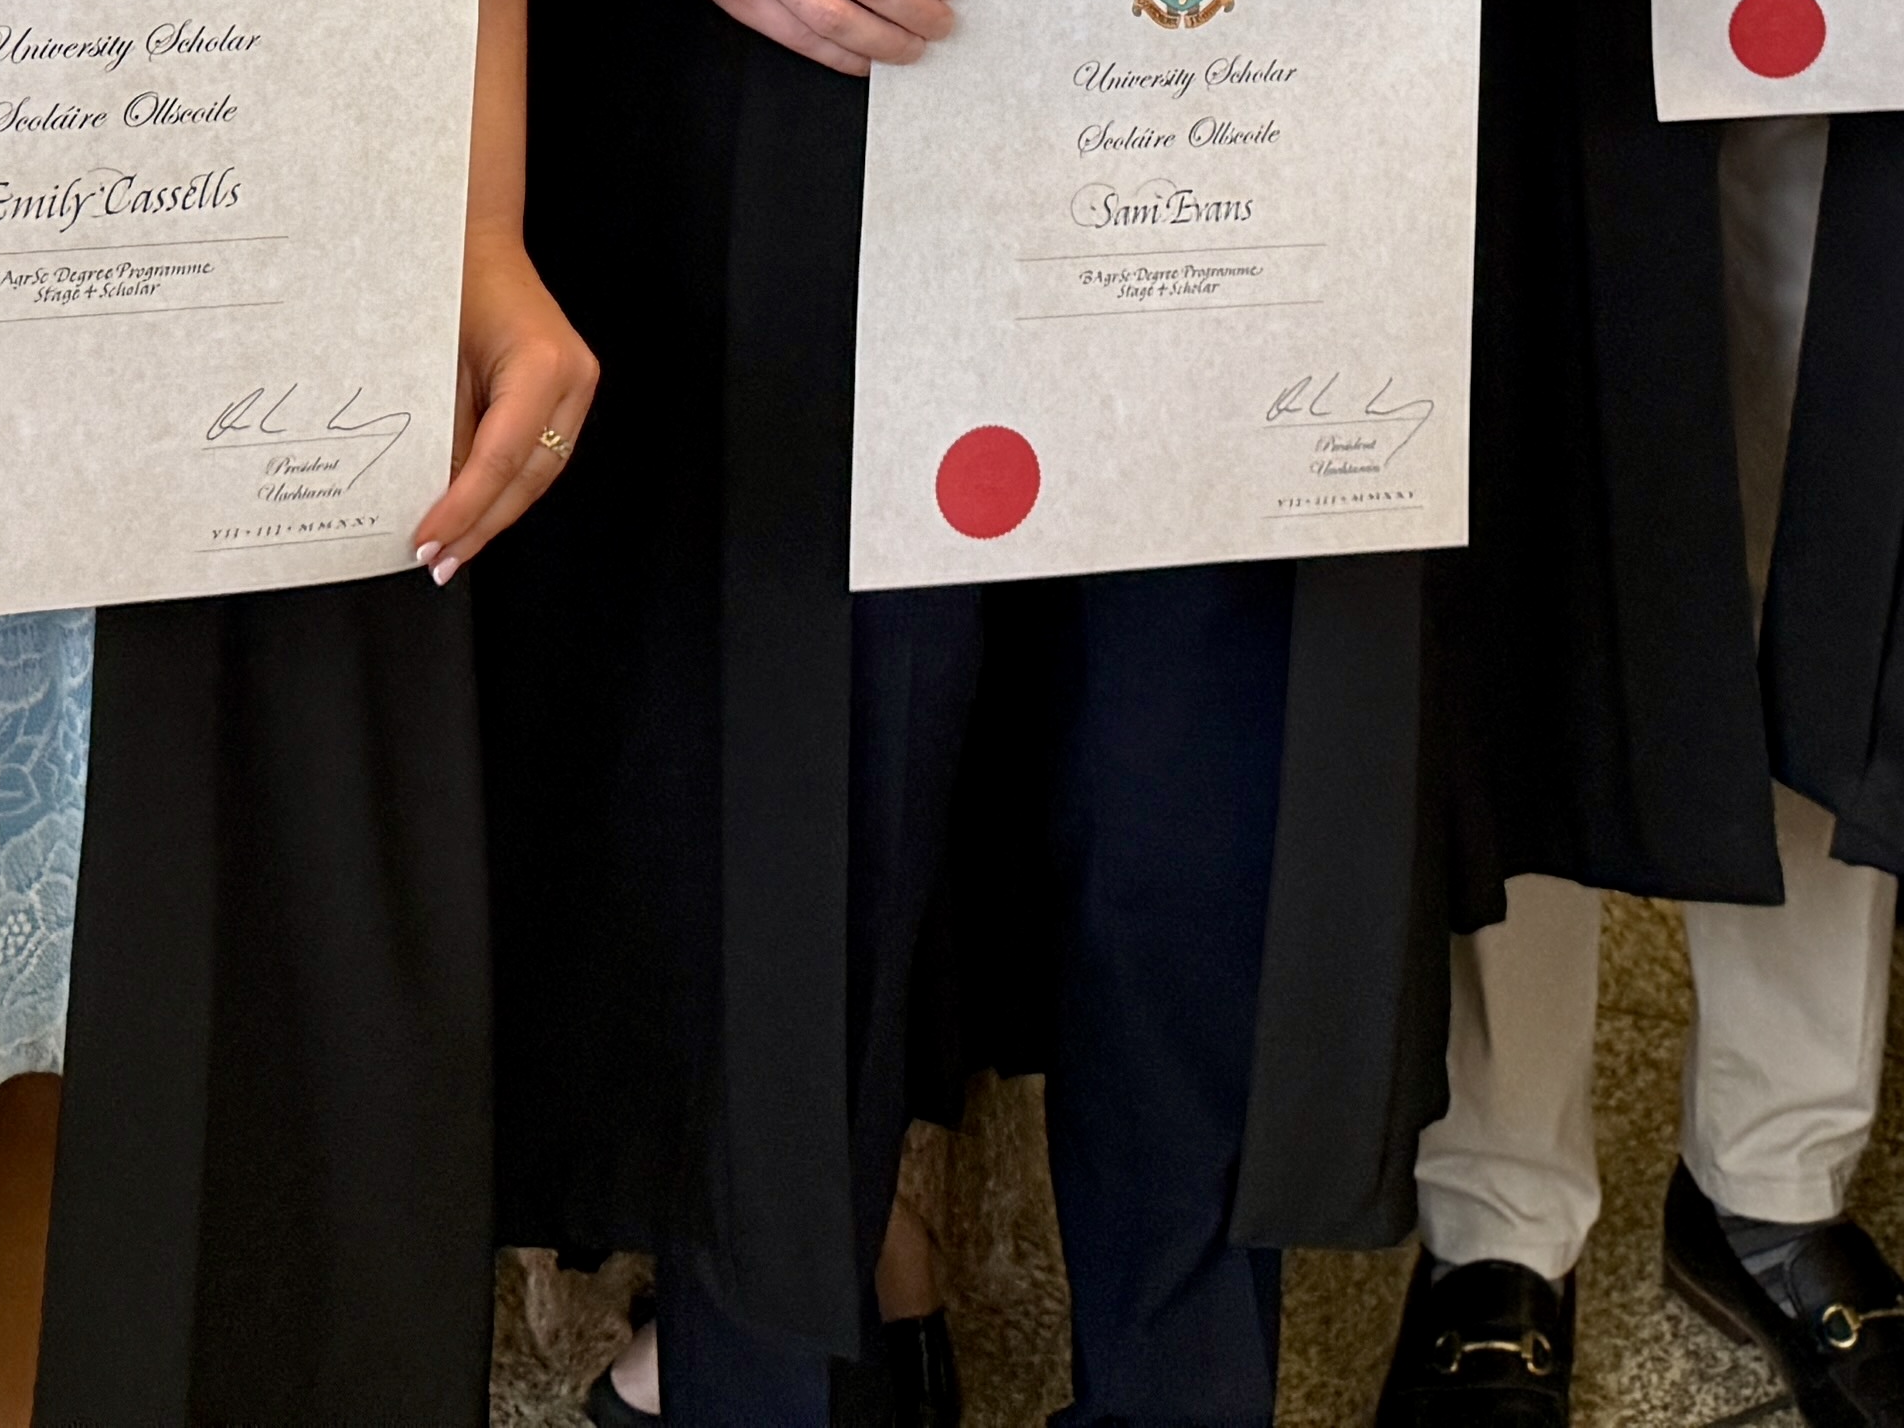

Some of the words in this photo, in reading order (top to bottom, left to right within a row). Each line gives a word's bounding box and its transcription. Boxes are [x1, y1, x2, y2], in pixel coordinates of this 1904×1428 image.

[146, 19, 261, 62] Scholar
[1073, 60, 1196, 100] University
[1204, 54, 1297, 92] Scholar
[124, 91, 237, 127] Ollscoile
[1077, 120, 1176, 159] Scoláire
[1188, 116, 1281, 148] Ollscoile
[105, 166, 242, 215] Cassells
[1091, 184, 1158, 229] Sam
[1166, 189, 1254, 225] Evans
[35, 286, 80, 304] Stage
[100, 282, 161, 298] Scholar
[54, 266, 113, 287] Degree
[115, 262, 215, 282] Programme
[1117, 284, 1153, 302] Stage
[1169, 281, 1220, 295] Scholar
[1133, 267, 1179, 284] Degree
[1181, 265, 1264, 283] Programme
